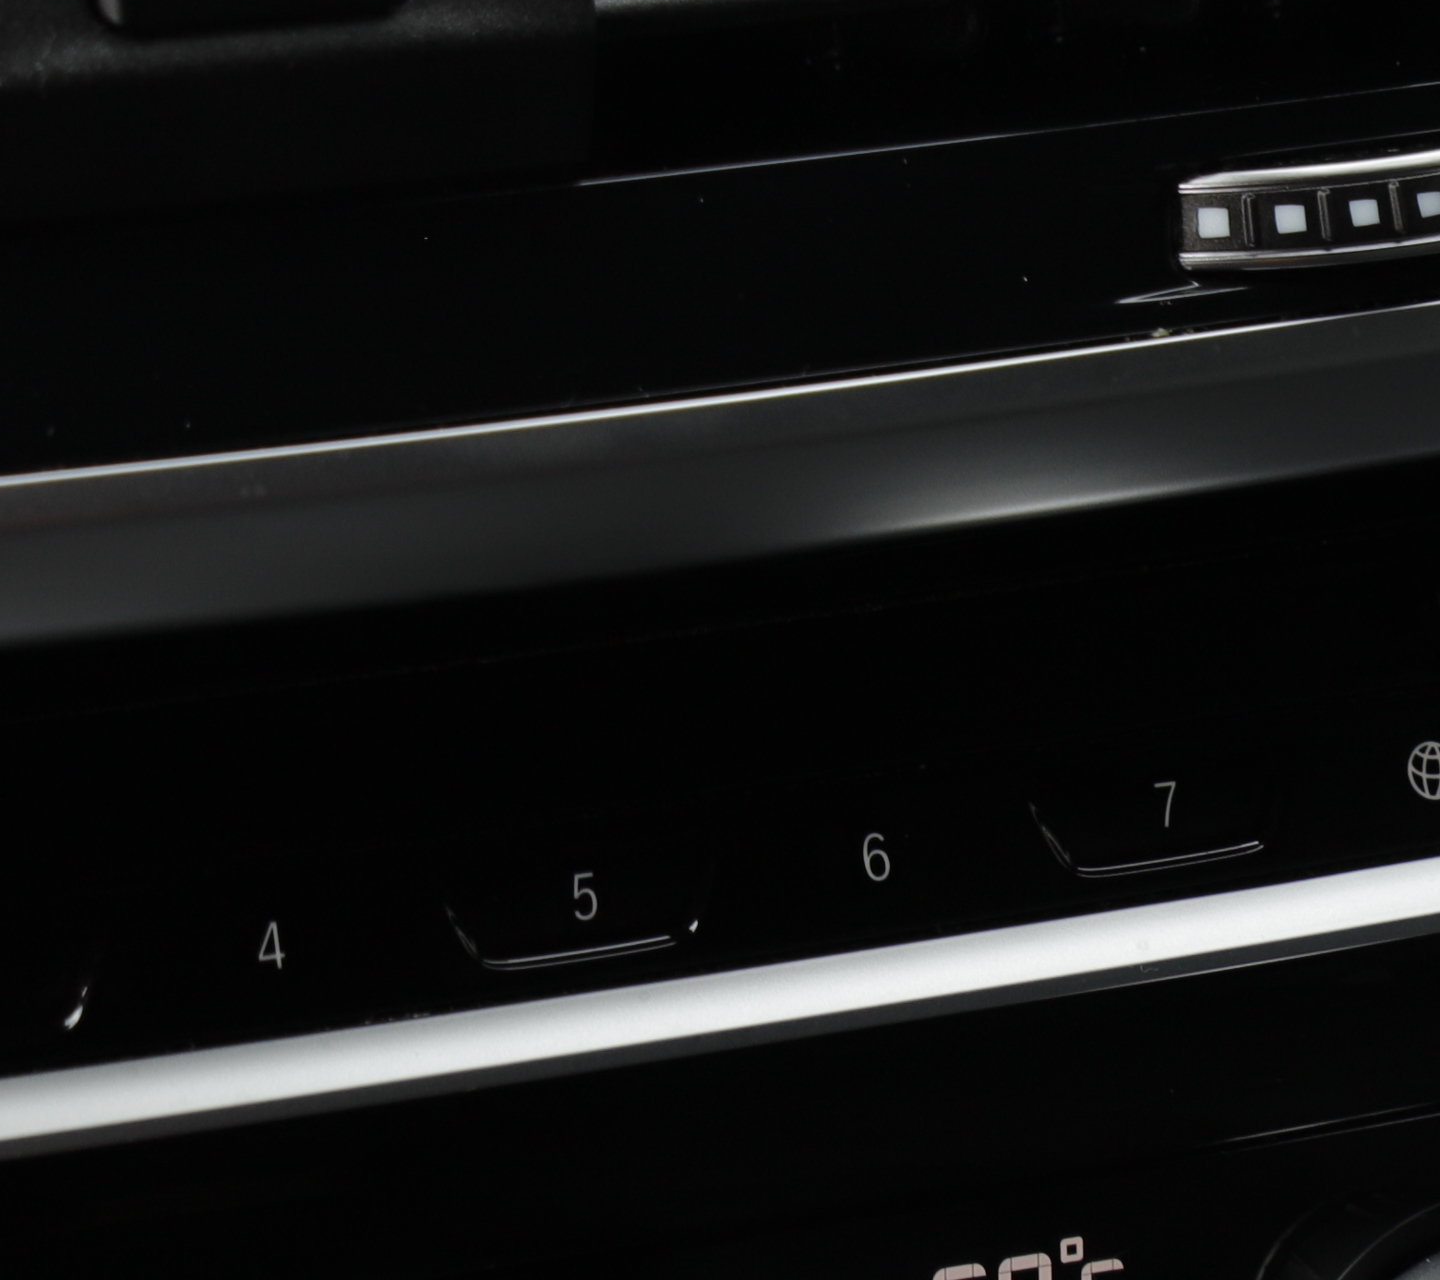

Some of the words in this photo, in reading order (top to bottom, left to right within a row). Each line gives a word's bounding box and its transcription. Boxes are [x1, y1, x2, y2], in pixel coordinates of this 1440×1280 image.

[1152, 780, 1177, 828] 7
[862, 832, 891, 881] 6
[572, 872, 598, 921] 5
[257, 921, 286, 971] 4
